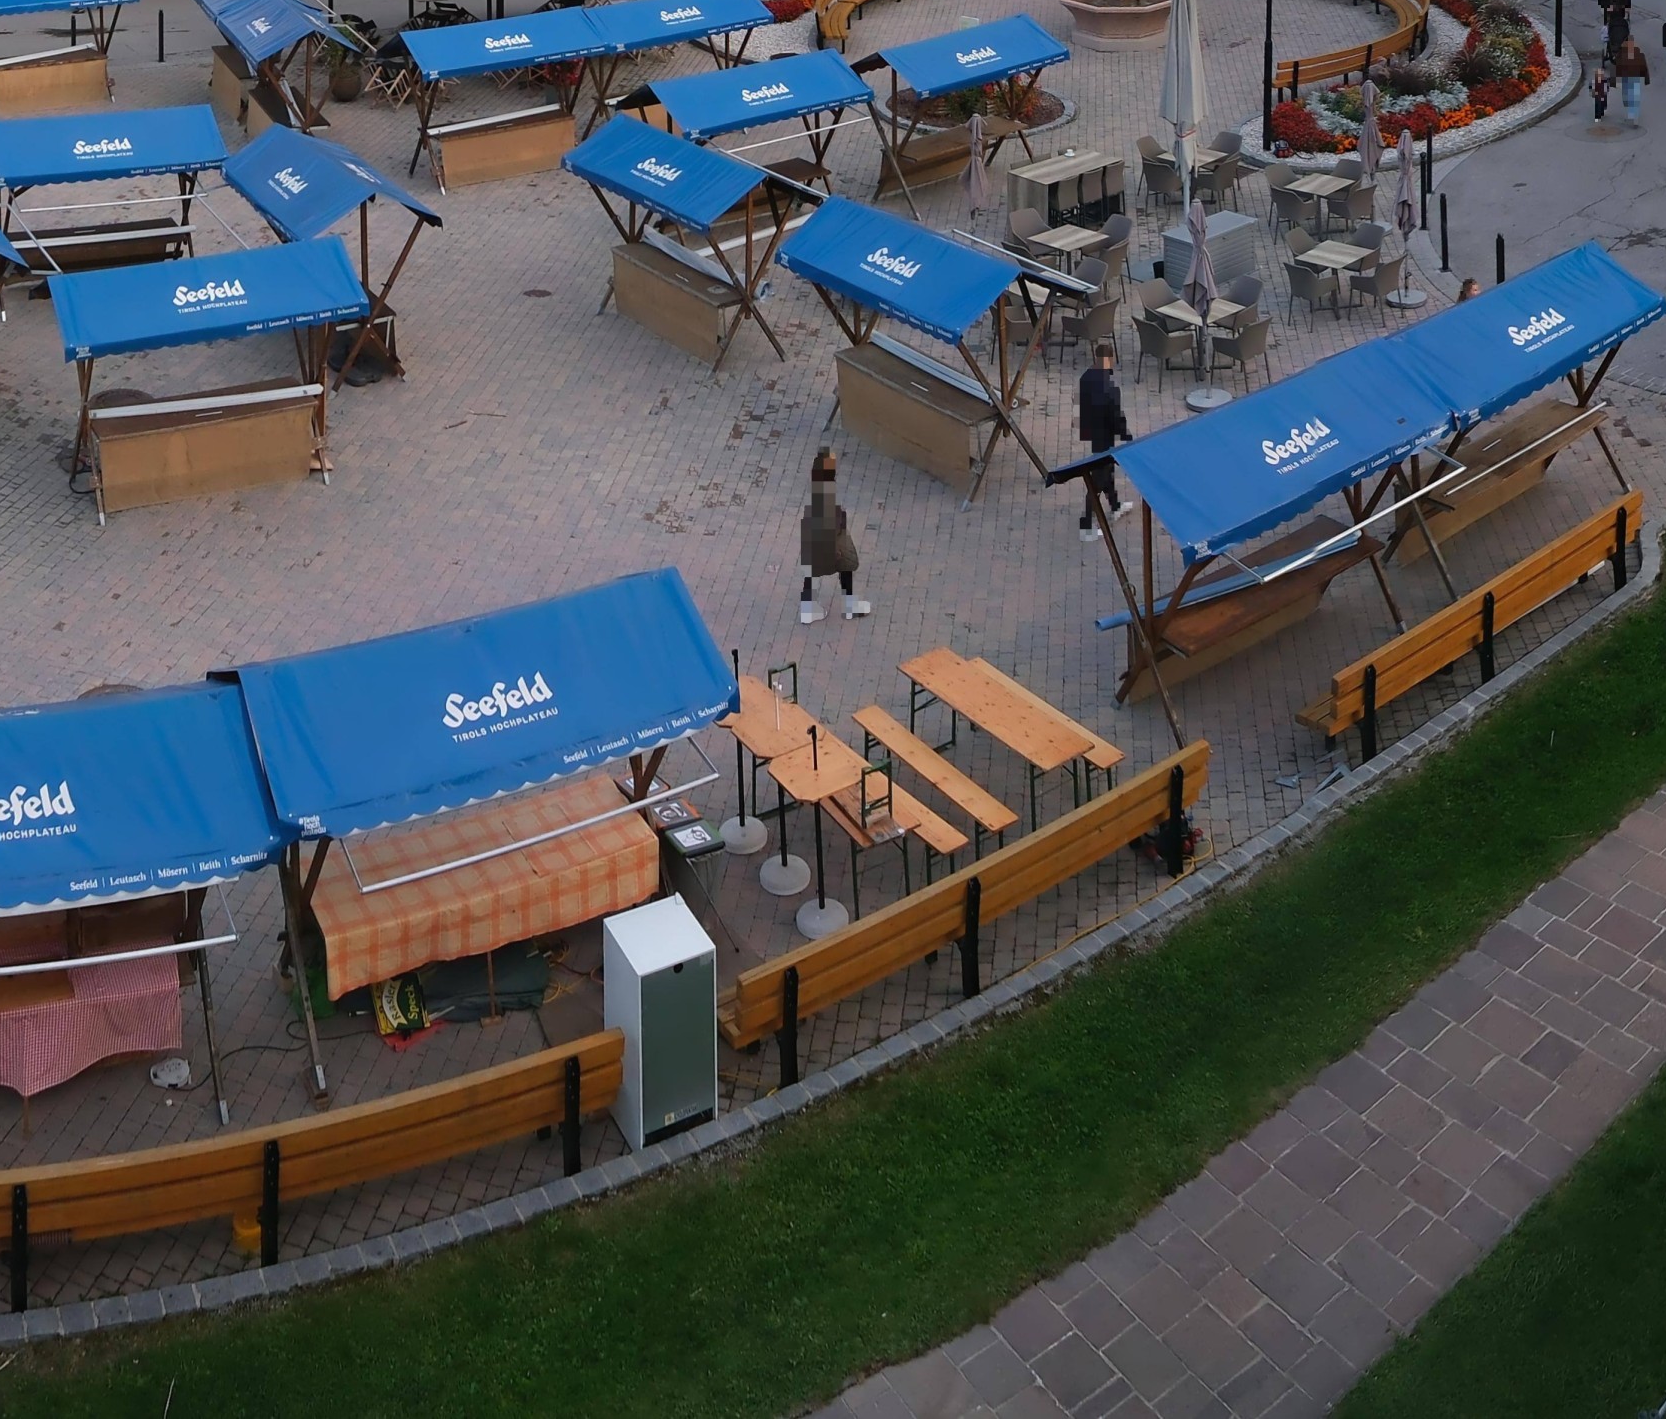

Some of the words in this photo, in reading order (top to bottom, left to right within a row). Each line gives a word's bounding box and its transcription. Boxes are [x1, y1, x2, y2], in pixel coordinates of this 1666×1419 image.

[659, 5, 702, 22] Seefeld
[484, 32, 531, 50] Seefeld
[955, 45, 998, 65] Seefeld
[741, 82, 790, 102] Seefeld
[72, 137, 133, 155] Seefeld
[274, 167, 309, 196] Seefeld
[636, 156, 683, 182] Seefeld
[866, 246, 922, 279] Seefeld
[172, 278, 246, 307] Seefeld
[1507, 306, 1566, 347] Seefeld
[1261, 416, 1332, 466] Seefeld
[442, 669, 554, 729] Seefeld
[451, 727, 488, 744] TIROLS
[489, 706, 560, 734] HOCHPLATEAU
[563, 749, 589, 764] Seefeld
[596, 736, 629, 754] Leutasch
[637, 724, 664, 740] Mösern
[671, 714, 691, 729] Reith
[697, 700, 730, 719] Scharnitz
[69, 877, 99, 892] Seefeld
[109, 871, 147, 887] Leutasch
[157, 865, 189, 880] Mösern
[198, 859, 221, 872] Reith
[230, 850, 269, 866] Scharnitz
[405, 983, 419, 1020] Speck
